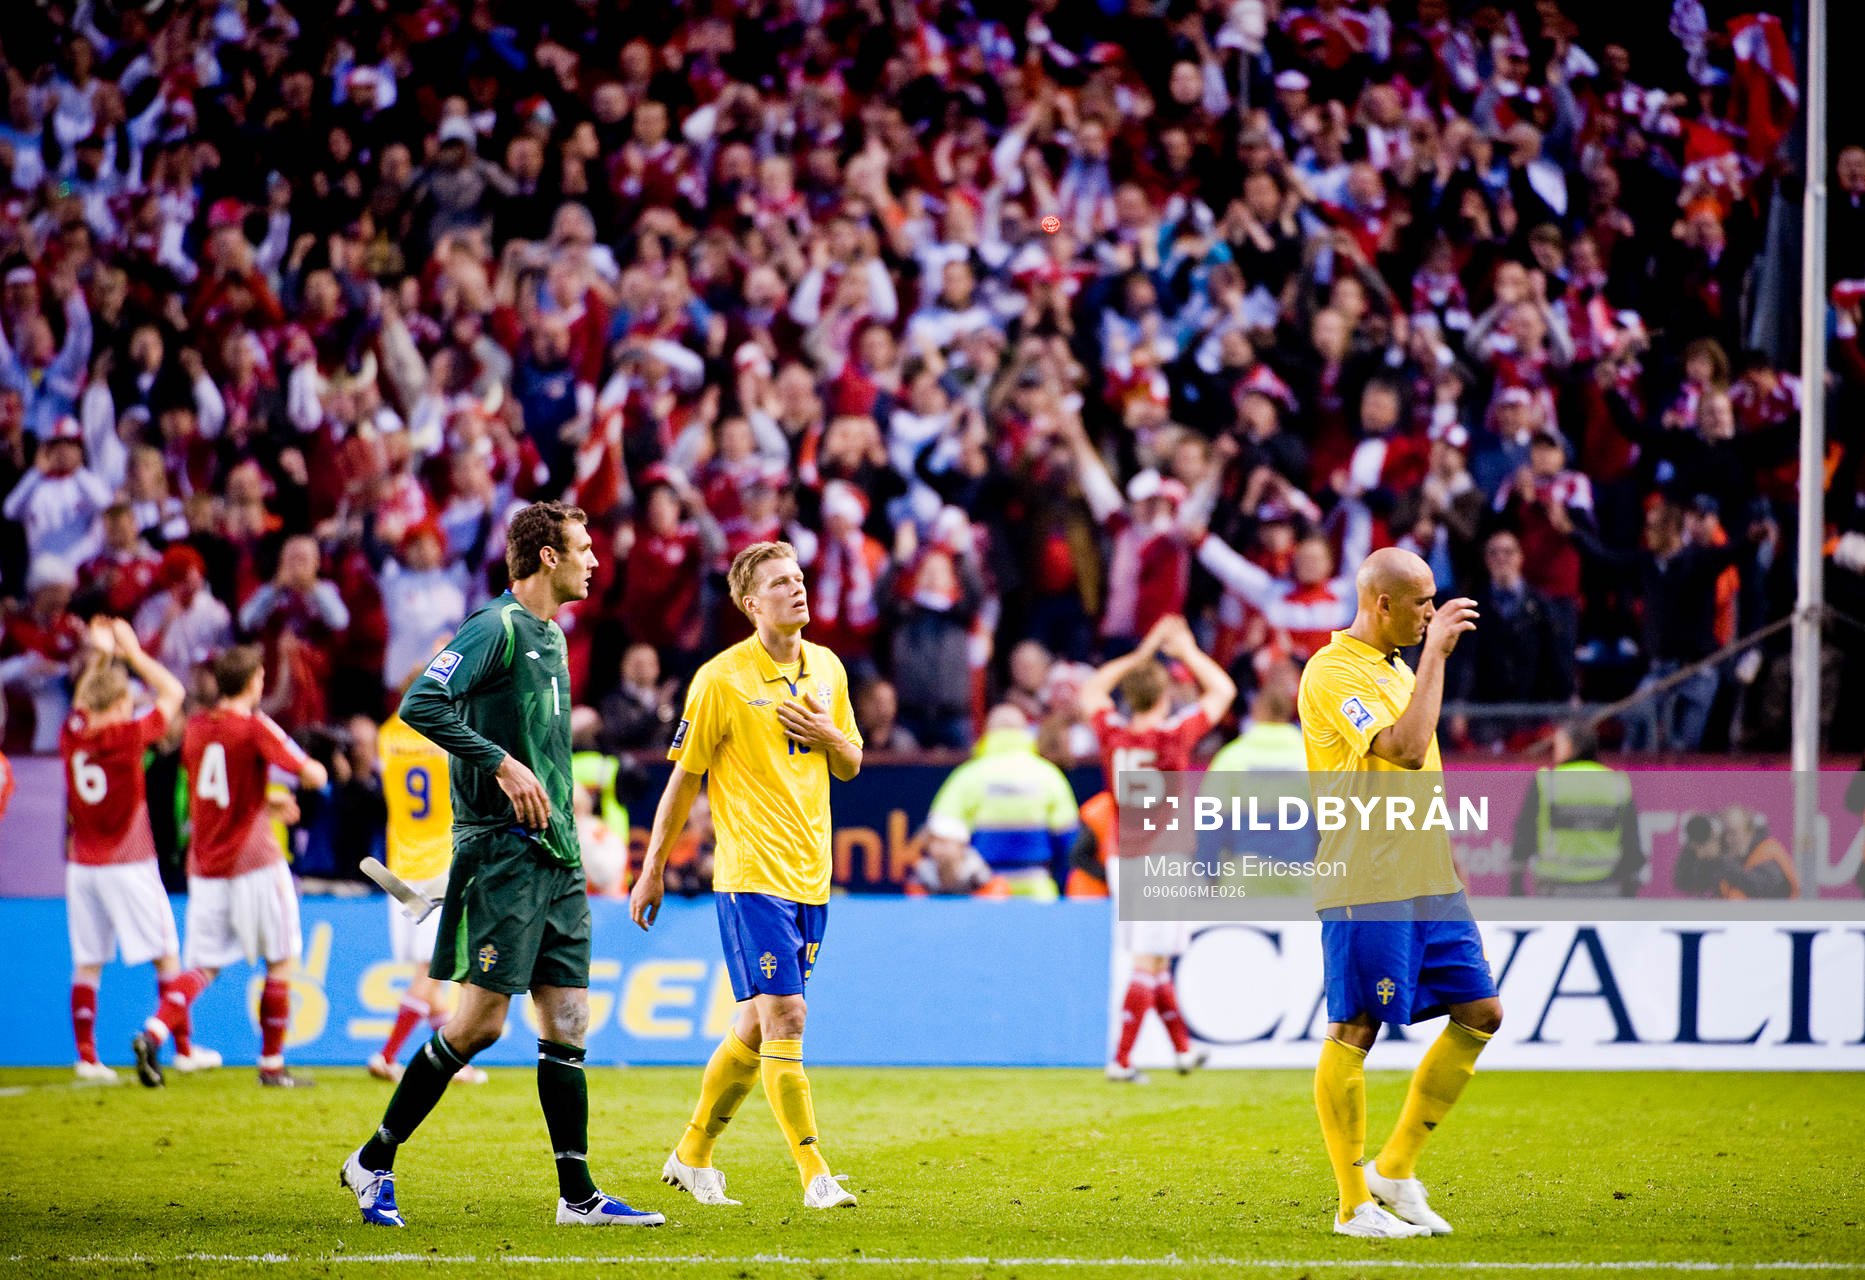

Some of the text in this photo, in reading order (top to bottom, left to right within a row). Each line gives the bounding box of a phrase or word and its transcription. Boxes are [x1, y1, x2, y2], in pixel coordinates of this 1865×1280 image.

[551, 676, 560, 716] 1
[71, 750, 108, 805] 6
[197, 742, 231, 809] 4
[405, 766, 431, 820] 9
[1113, 748, 1166, 808] 15
[1172, 922, 1865, 1046] CALI
